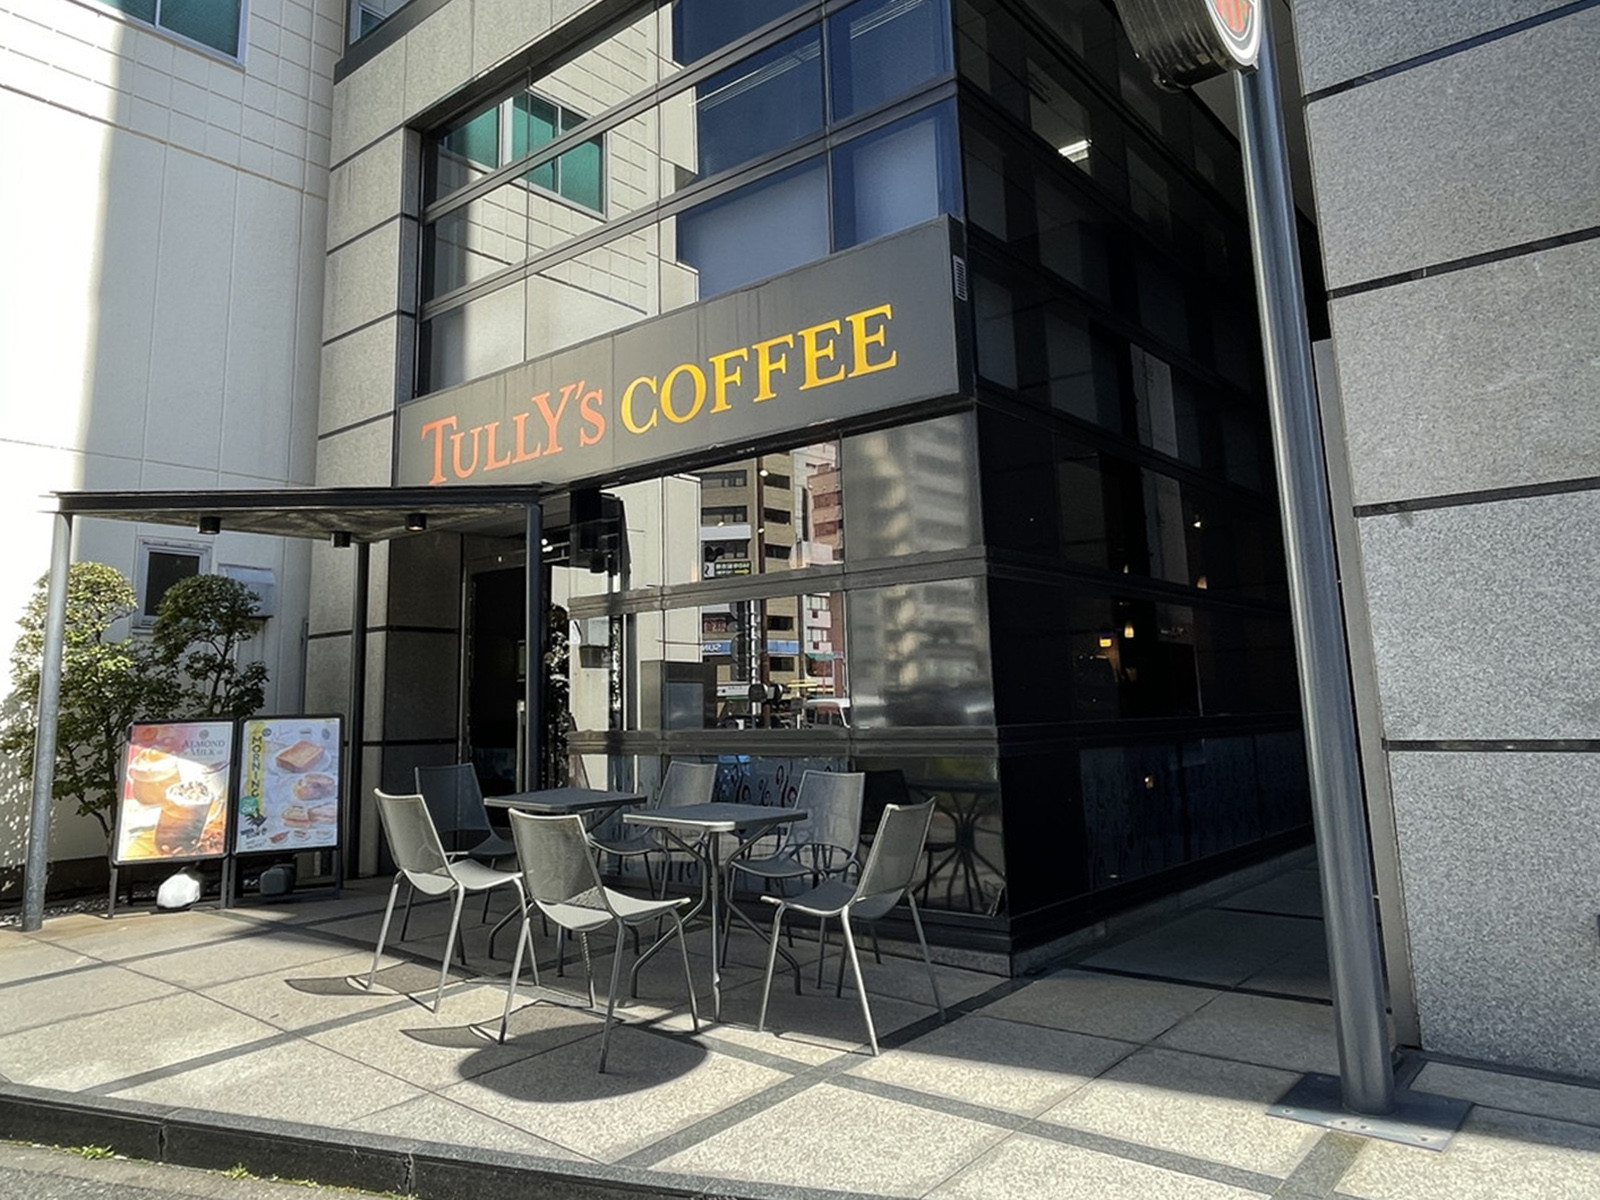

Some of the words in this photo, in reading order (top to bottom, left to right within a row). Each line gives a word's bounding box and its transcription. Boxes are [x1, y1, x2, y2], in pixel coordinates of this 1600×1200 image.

[619, 303, 898, 434] COFFEE
[181, 738, 225, 750] ALMOND
[251, 736, 263, 798] MORNING
